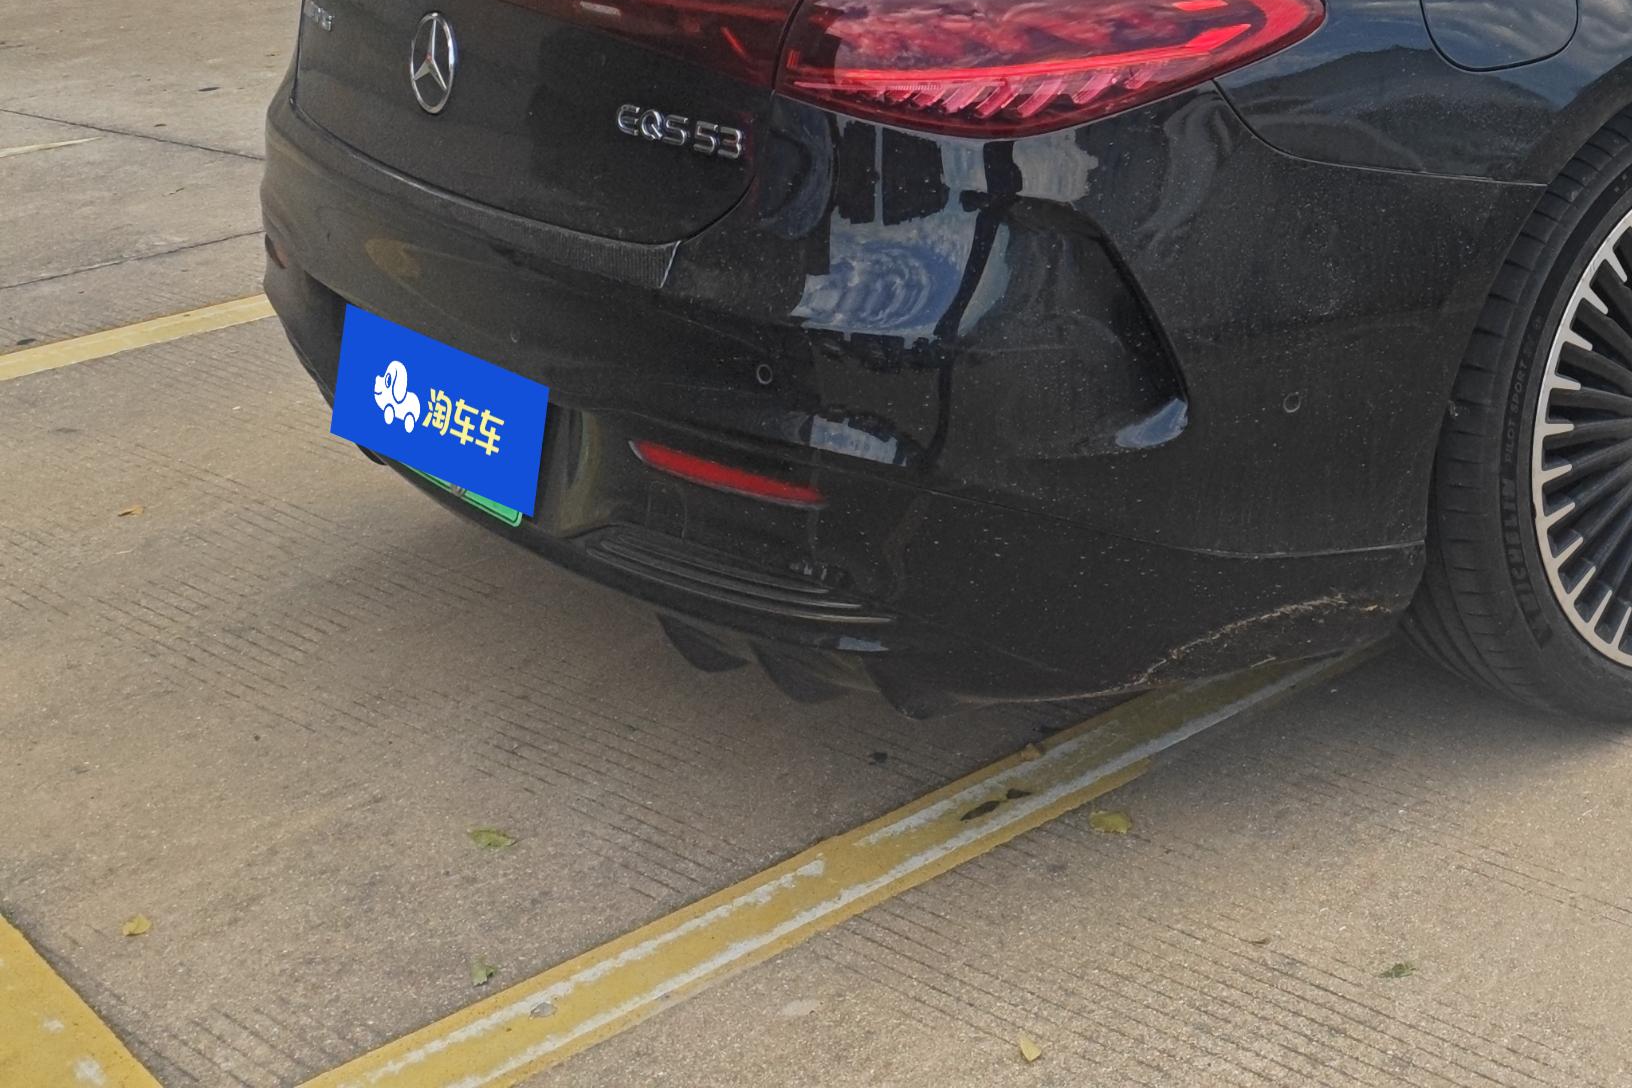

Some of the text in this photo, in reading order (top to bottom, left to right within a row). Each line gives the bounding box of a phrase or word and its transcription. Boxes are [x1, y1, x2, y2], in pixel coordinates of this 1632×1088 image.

[618, 104, 741, 159] EQS 53
[1504, 418, 1516, 463] PILOT
[1510, 359, 1528, 414] SPORT
